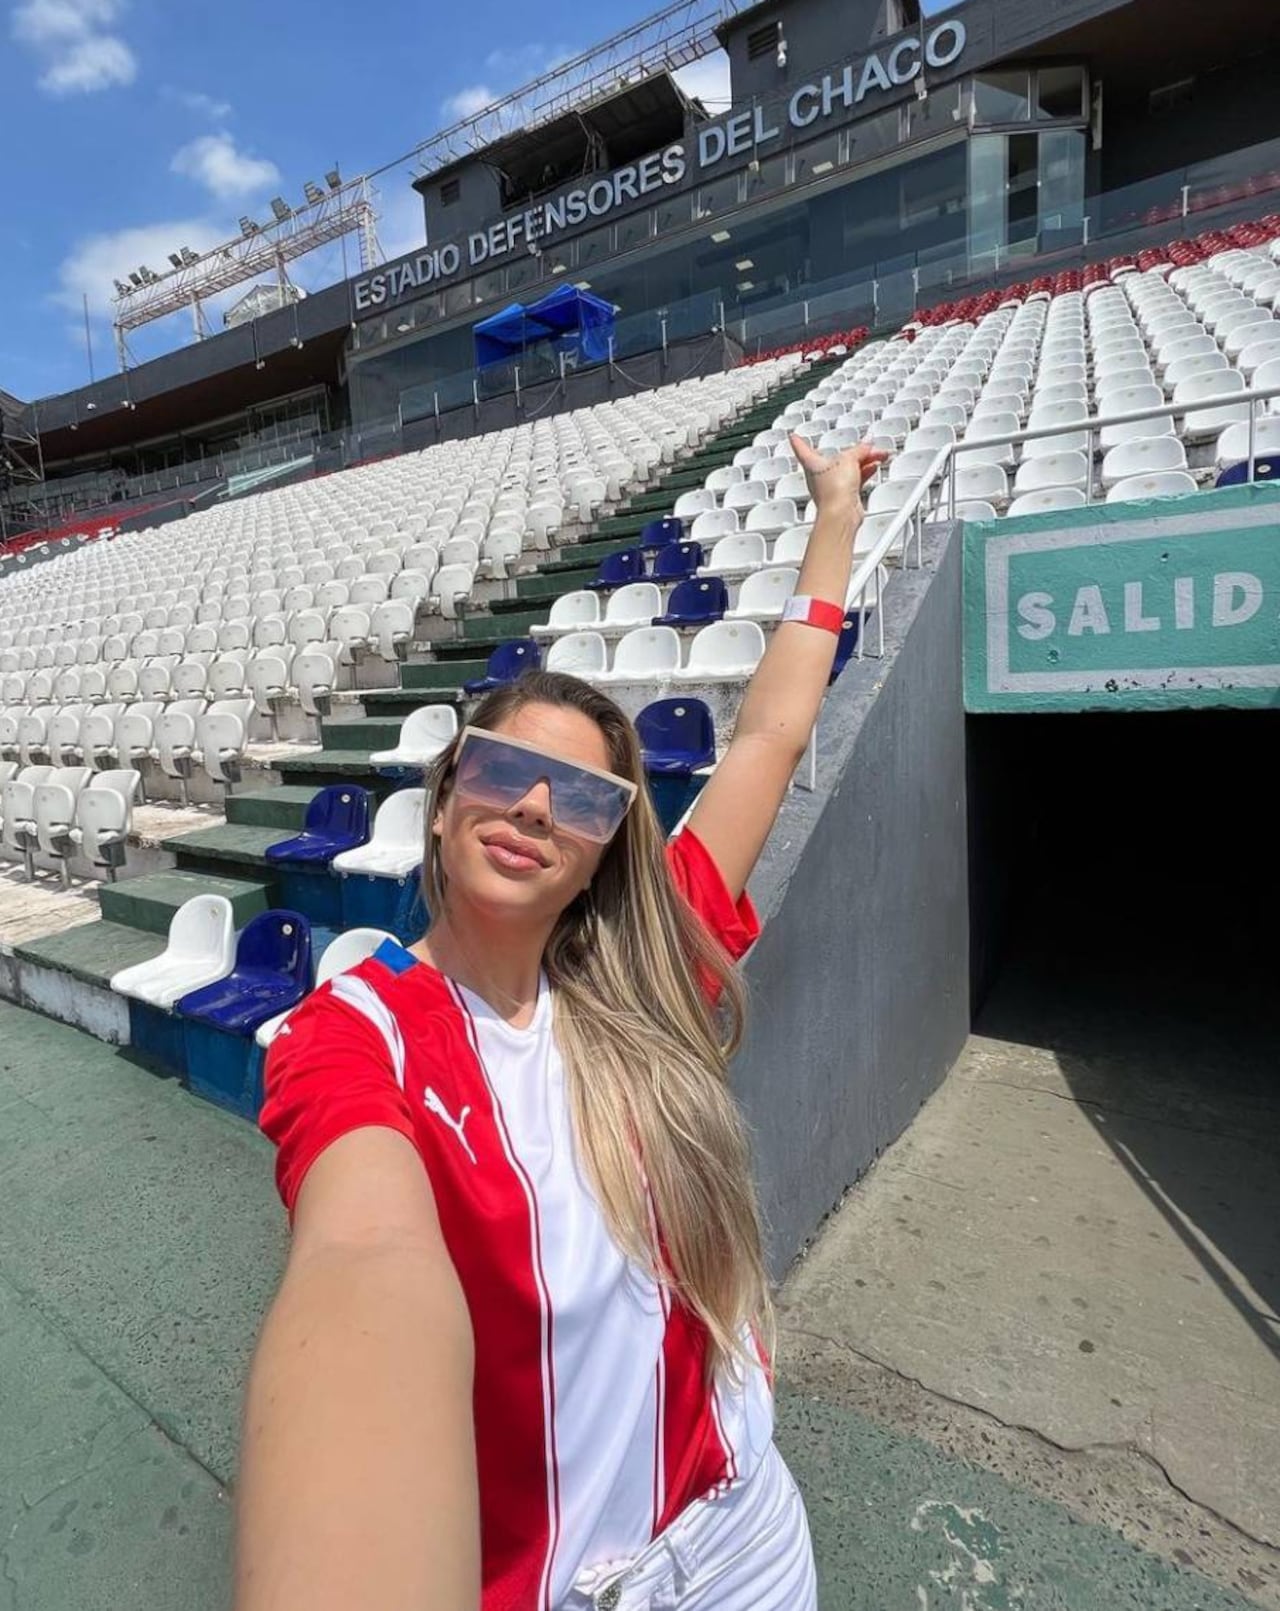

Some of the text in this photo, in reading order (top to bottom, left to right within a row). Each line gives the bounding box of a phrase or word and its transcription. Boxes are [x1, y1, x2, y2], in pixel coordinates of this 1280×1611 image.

[354, 20, 966, 310] ESTADIO DEFENSORES DEL CHACO
[1016, 571, 1264, 640] SALID
